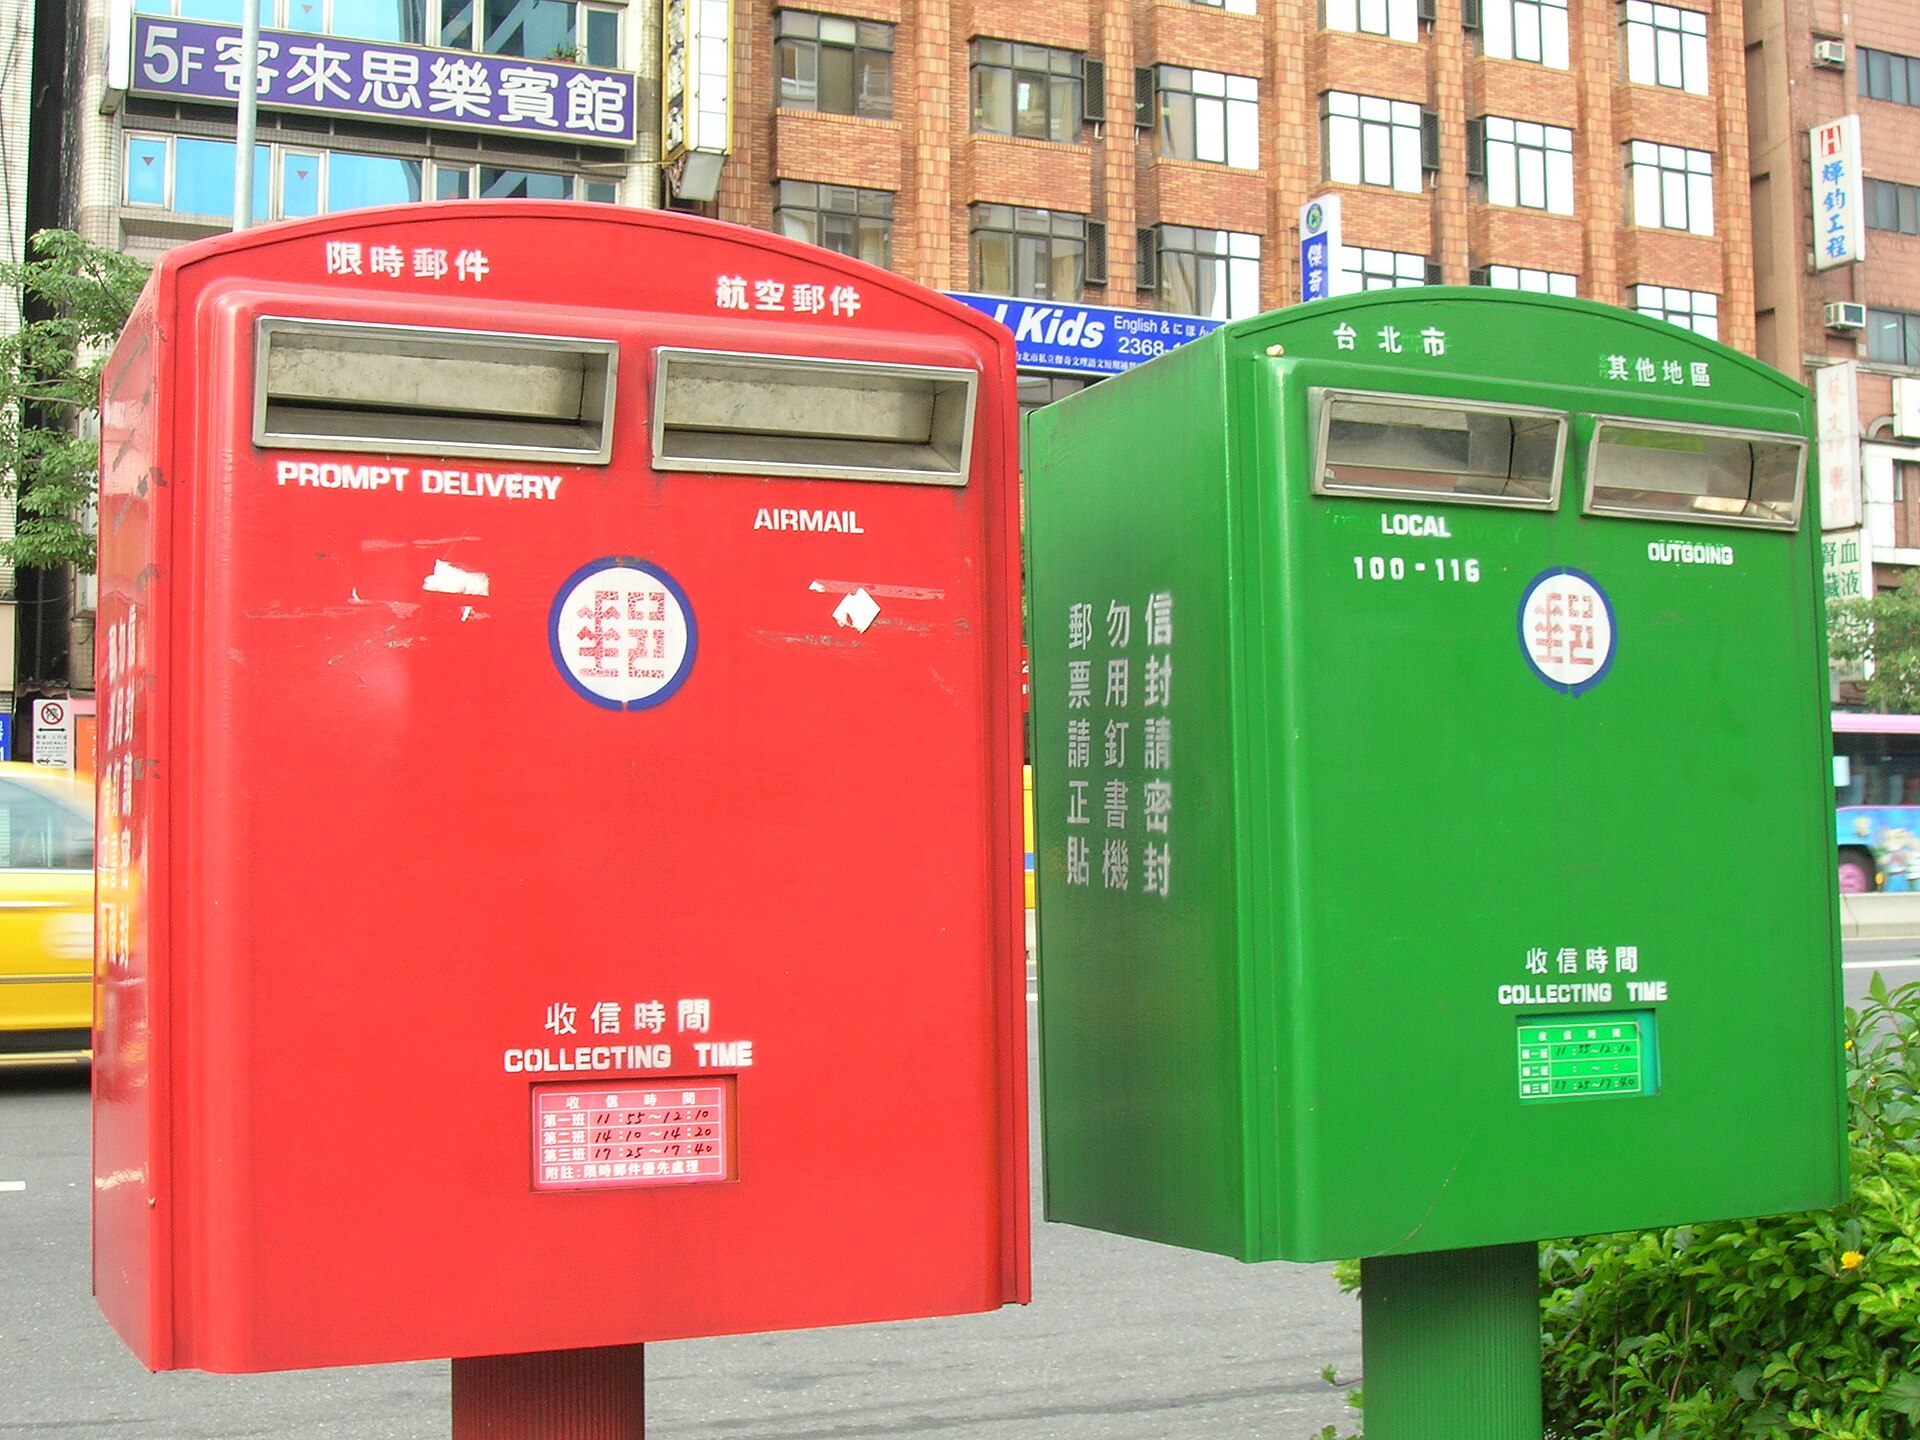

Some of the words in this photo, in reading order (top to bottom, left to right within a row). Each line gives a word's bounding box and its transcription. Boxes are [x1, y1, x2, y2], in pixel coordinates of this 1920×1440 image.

[143, 25, 205, 85] 5F
[214, 36, 627, 134] 客來思樂賓館
[326, 241, 490, 282] 限時郵件
[1307, 242, 1323, 300] 傑奇
[716, 274, 862, 317] 航空郵件
[1015, 305, 1106, 349] Kids
[1113, 315, 1158, 334] English
[1160, 319, 1171, 335] &
[1333, 322, 1446, 357] 台北市
[1608, 355, 1711, 387] 其他地區
[277, 460, 408, 491] PROMPT
[421, 468, 562, 501] DELIVERY
[754, 508, 865, 534] AIRMAIL
[1381, 514, 1452, 538] LOCAL
[1647, 541, 1734, 566] OUTGOING
[1840, 539, 1859, 596] 血液
[1066, 602, 1093, 887] 郵票請正貼
[1102, 599, 1131, 891] 勿用釘書機
[1144, 591, 1174, 897] 信封請密封
[1525, 946, 1638, 975] 收信時間
[1498, 982, 1613, 1005] COLLECTING
[1626, 981, 1668, 1002] TIME
[545, 998, 711, 1035] 收信時間
[504, 1044, 672, 1073] COLLECTING
[693, 1041, 753, 1068] TIME
[566, 1091, 697, 1110] 收信時間
[543, 1112, 586, 1129] 第一班
[543, 1129, 586, 1146] 第二班
[543, 1146, 586, 1163] 第三班
